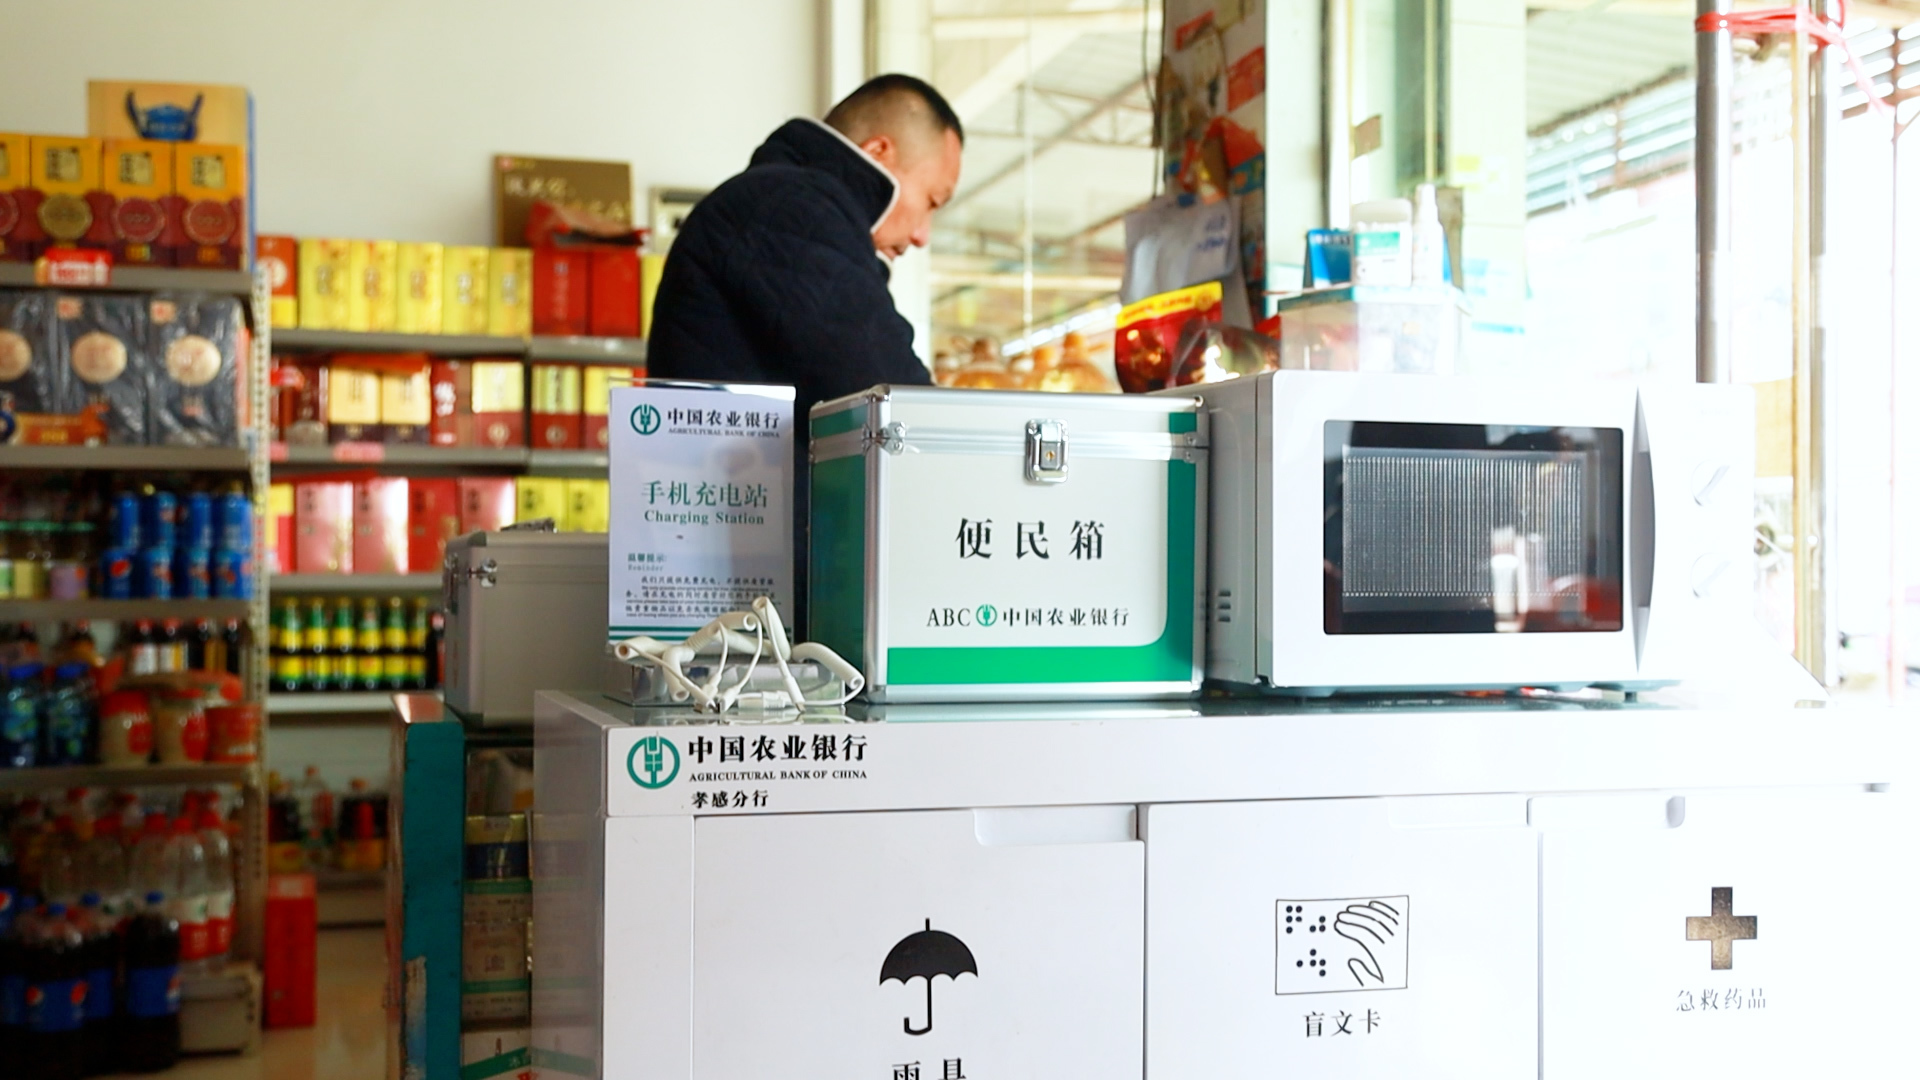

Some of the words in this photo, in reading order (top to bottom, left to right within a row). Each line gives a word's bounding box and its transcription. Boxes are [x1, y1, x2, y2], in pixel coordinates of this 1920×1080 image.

[667, 407, 781, 430] 中国农业银行
[668, 428, 722, 436] AGRICULTURAL
[724, 429, 744, 437] BANK
[641, 480, 768, 508] 手机充电站
[644, 510, 709, 526] Charging
[715, 510, 764, 525] Station
[956, 517, 1106, 561] 便民箱
[927, 608, 971, 627] ABC
[1002, 607, 1130, 627] 中国农业银行
[688, 734, 869, 764] 中国农业银行
[689, 770, 776, 783] AGRICULTURAL
[780, 770, 811, 780] BANK
[812, 770, 829, 780] OF
[832, 770, 868, 780] CHINA
[691, 789, 769, 809] 孝感分行
[1676, 987, 1766, 1012] 急救药品
[1303, 1009, 1382, 1038] 盲文卡
[891, 1057, 967, 1080] 雨具
